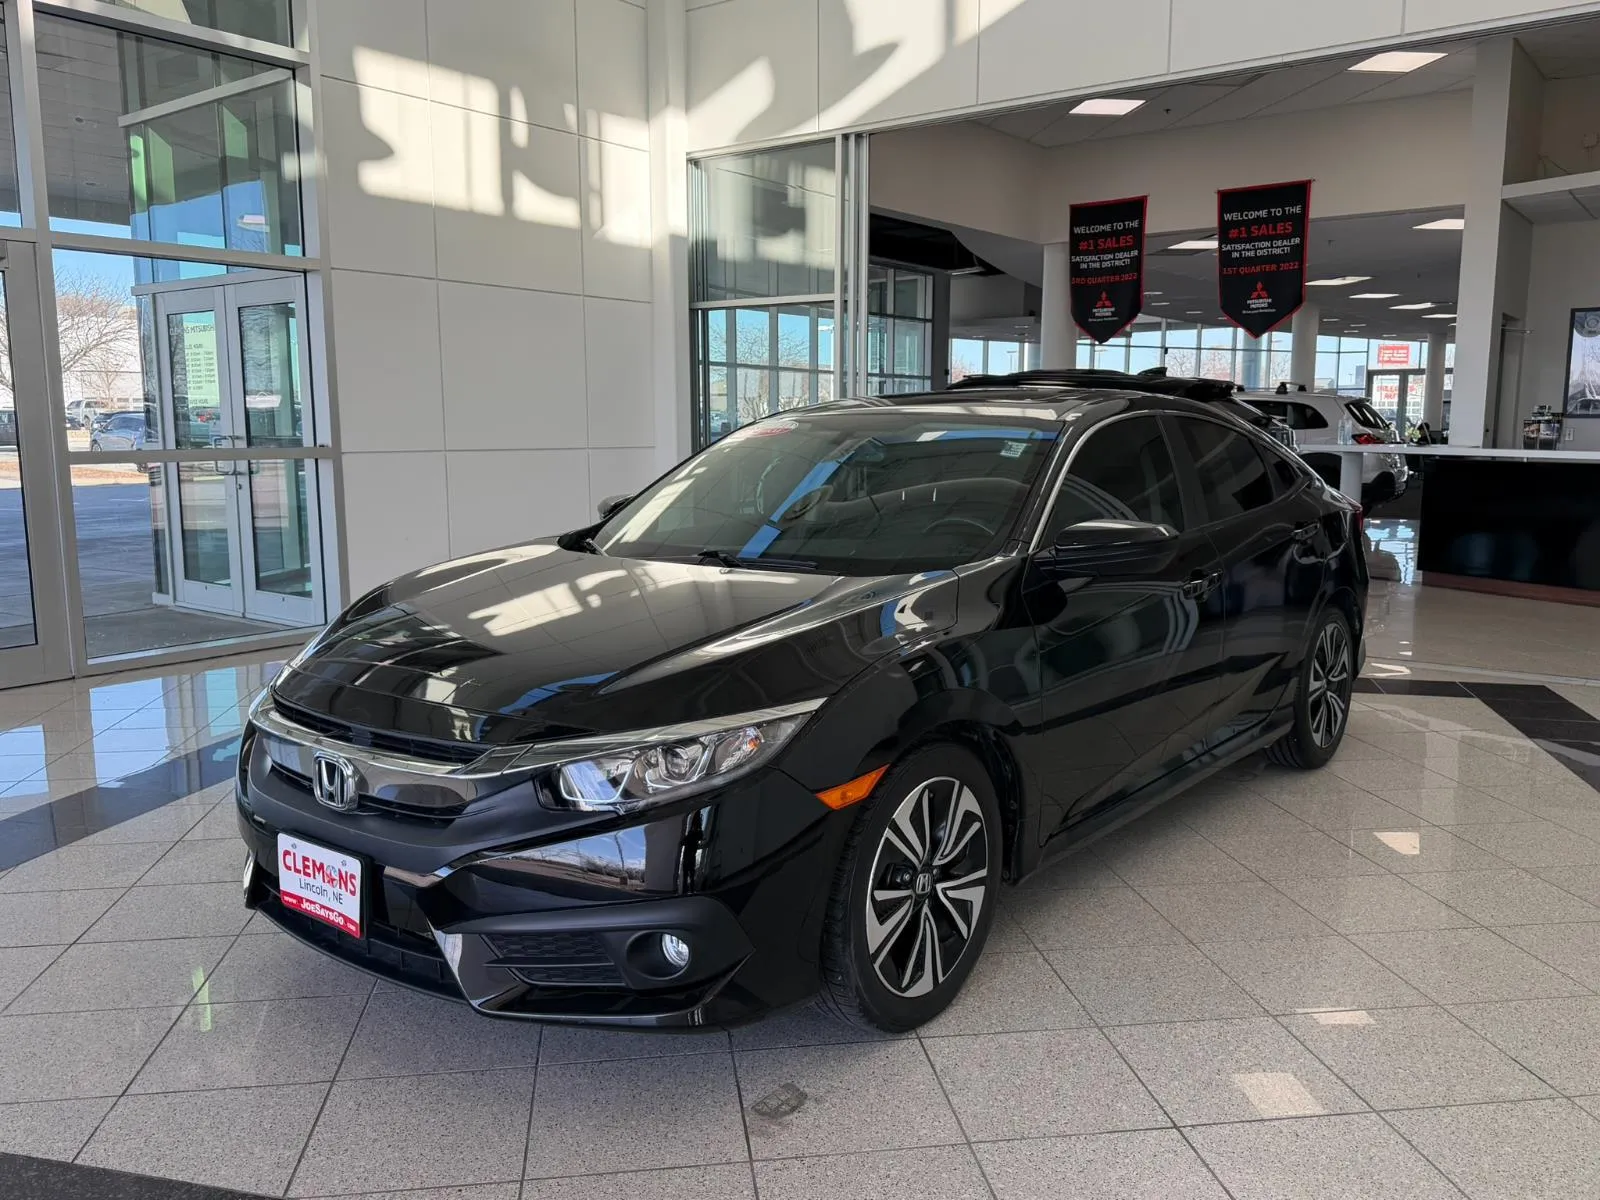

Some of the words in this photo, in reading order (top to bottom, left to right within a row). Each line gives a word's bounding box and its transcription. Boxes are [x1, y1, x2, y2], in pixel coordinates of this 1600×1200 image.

[1223, 209, 1268, 221] WELCOME
[1270, 207, 1282, 217] TO
[1284, 205, 1302, 215] THE
[1073, 223, 1112, 234] WELCOME
[1113, 222, 1123, 231] TO
[1125, 219, 1140, 229] THE
[1228, 226, 1247, 239] #1
[1250, 221, 1293, 237] SALES
[1078, 239, 1094, 251] #1
[1097, 234, 1134, 249] SALES
[1221, 241, 1271, 251] SATISFACTION
[1272, 237, 1300, 247] DEALER
[1071, 253, 1114, 262] SATISFACTION
[1115, 250, 1139, 259] DEALER
[1241, 250, 1255, 258] THE
[1256, 246, 1291, 257] DISTRICT!
[1089, 261, 1101, 269] THE
[1101, 258, 1131, 268] DISTRICT!
[1223, 267, 1237, 275] 1ST
[1239, 264, 1278, 275] QUARTER
[1279, 261, 1300, 271] 2022
[1087, 273, 1119, 284] QUARTER
[282, 849, 357, 897] CLEMONS
[299, 877, 331, 902] Lincoln,
[333, 891, 344, 905] NE
